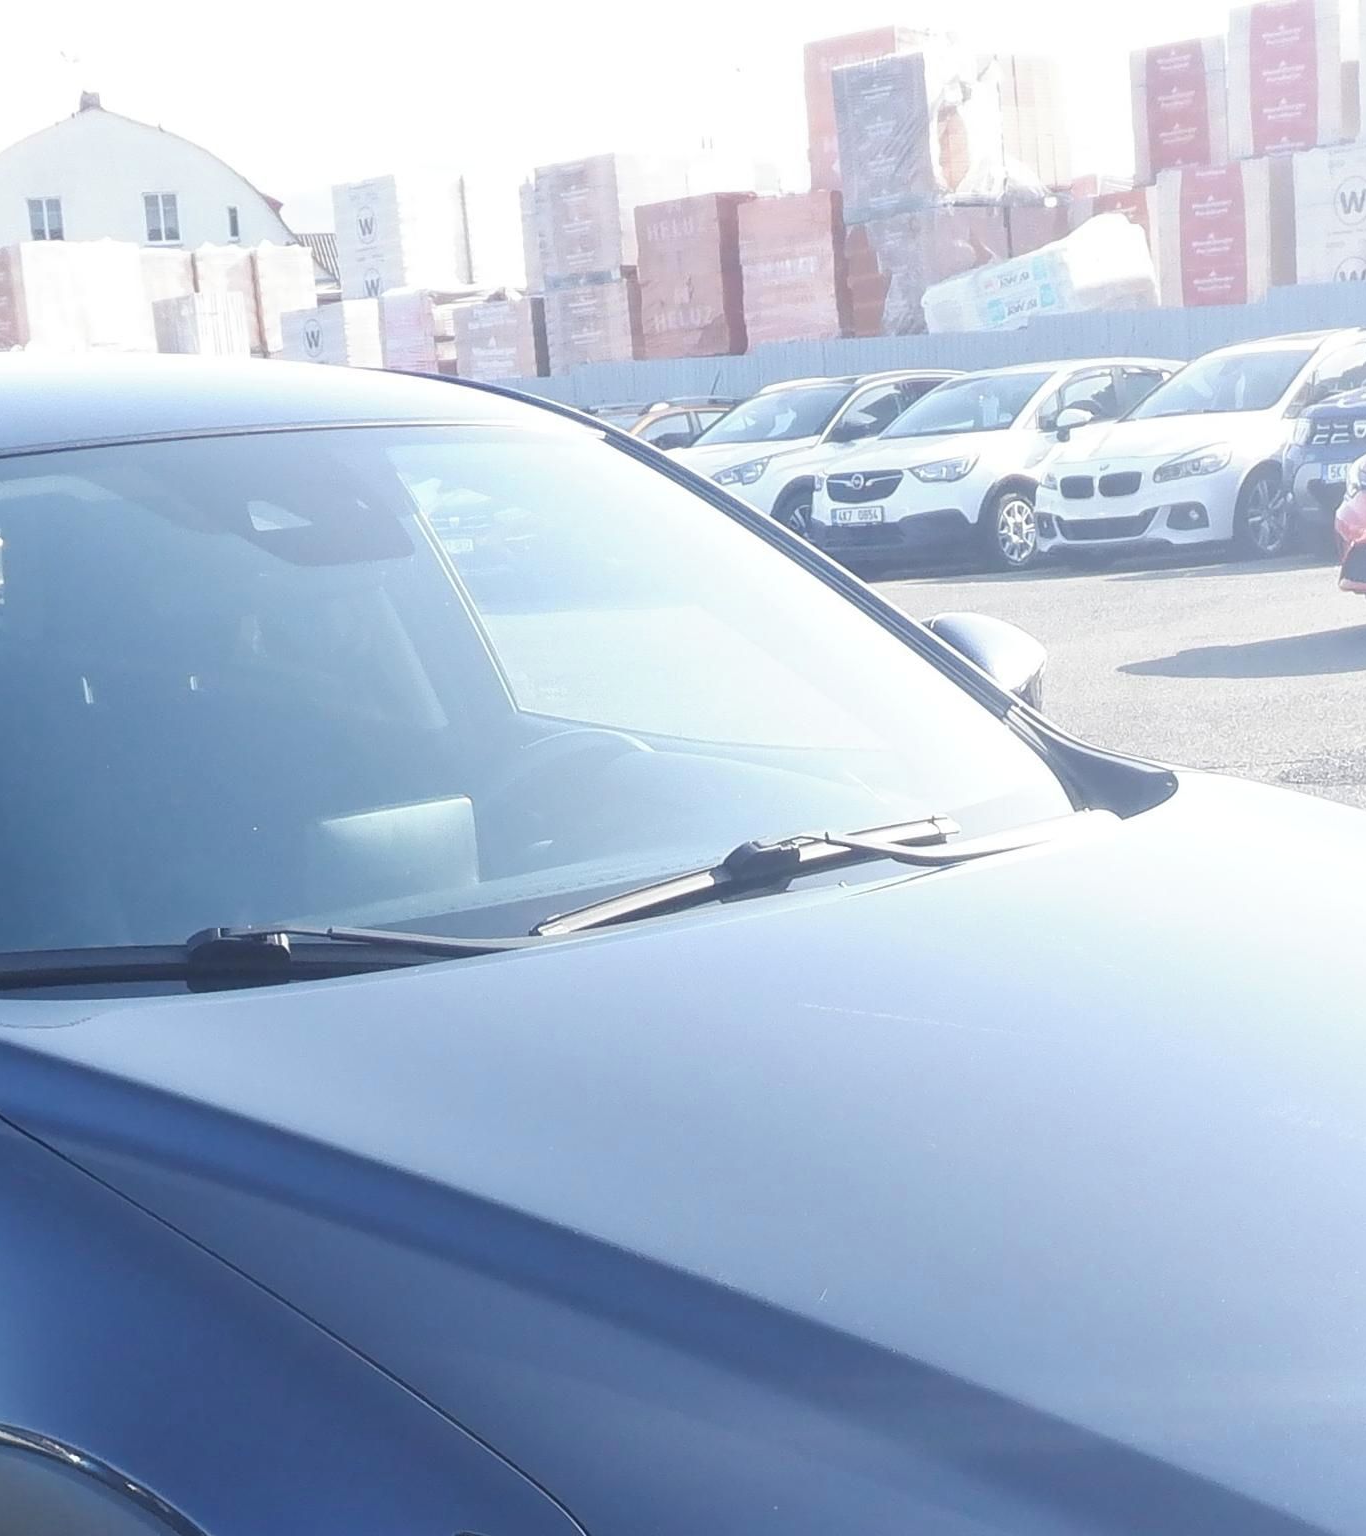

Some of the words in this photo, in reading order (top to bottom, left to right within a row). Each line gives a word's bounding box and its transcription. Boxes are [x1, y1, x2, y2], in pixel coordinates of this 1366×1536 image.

[1339, 188, 1366, 215] W
[358, 216, 374, 237] W
[305, 329, 321, 349] W
